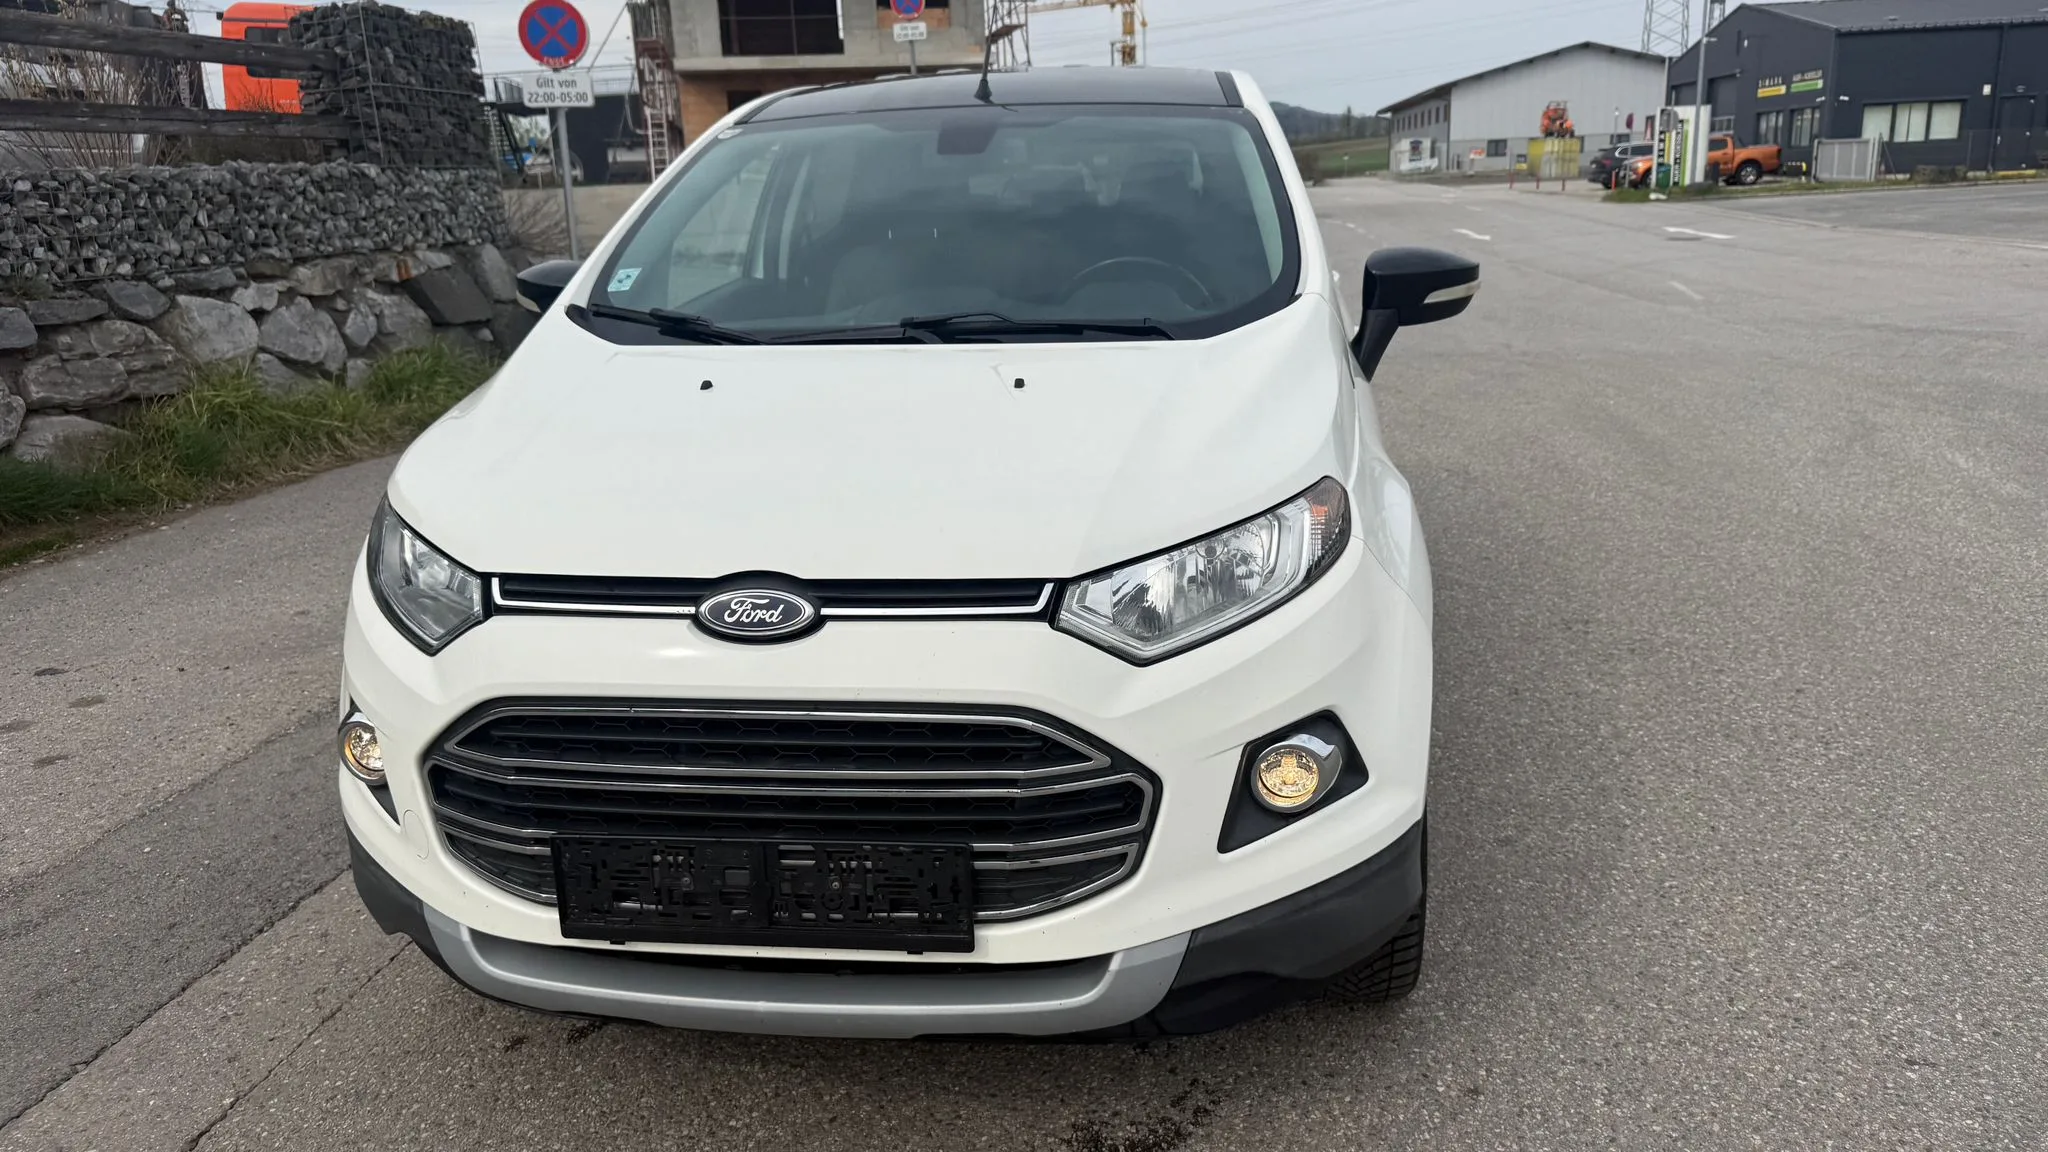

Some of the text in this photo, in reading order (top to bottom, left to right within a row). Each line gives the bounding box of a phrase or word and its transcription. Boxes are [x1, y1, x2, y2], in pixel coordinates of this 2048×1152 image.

[536, 77, 577, 89] Gilt von
[528, 91, 588, 104] 22:00-05:00
[724, 598, 784, 622] Ford
